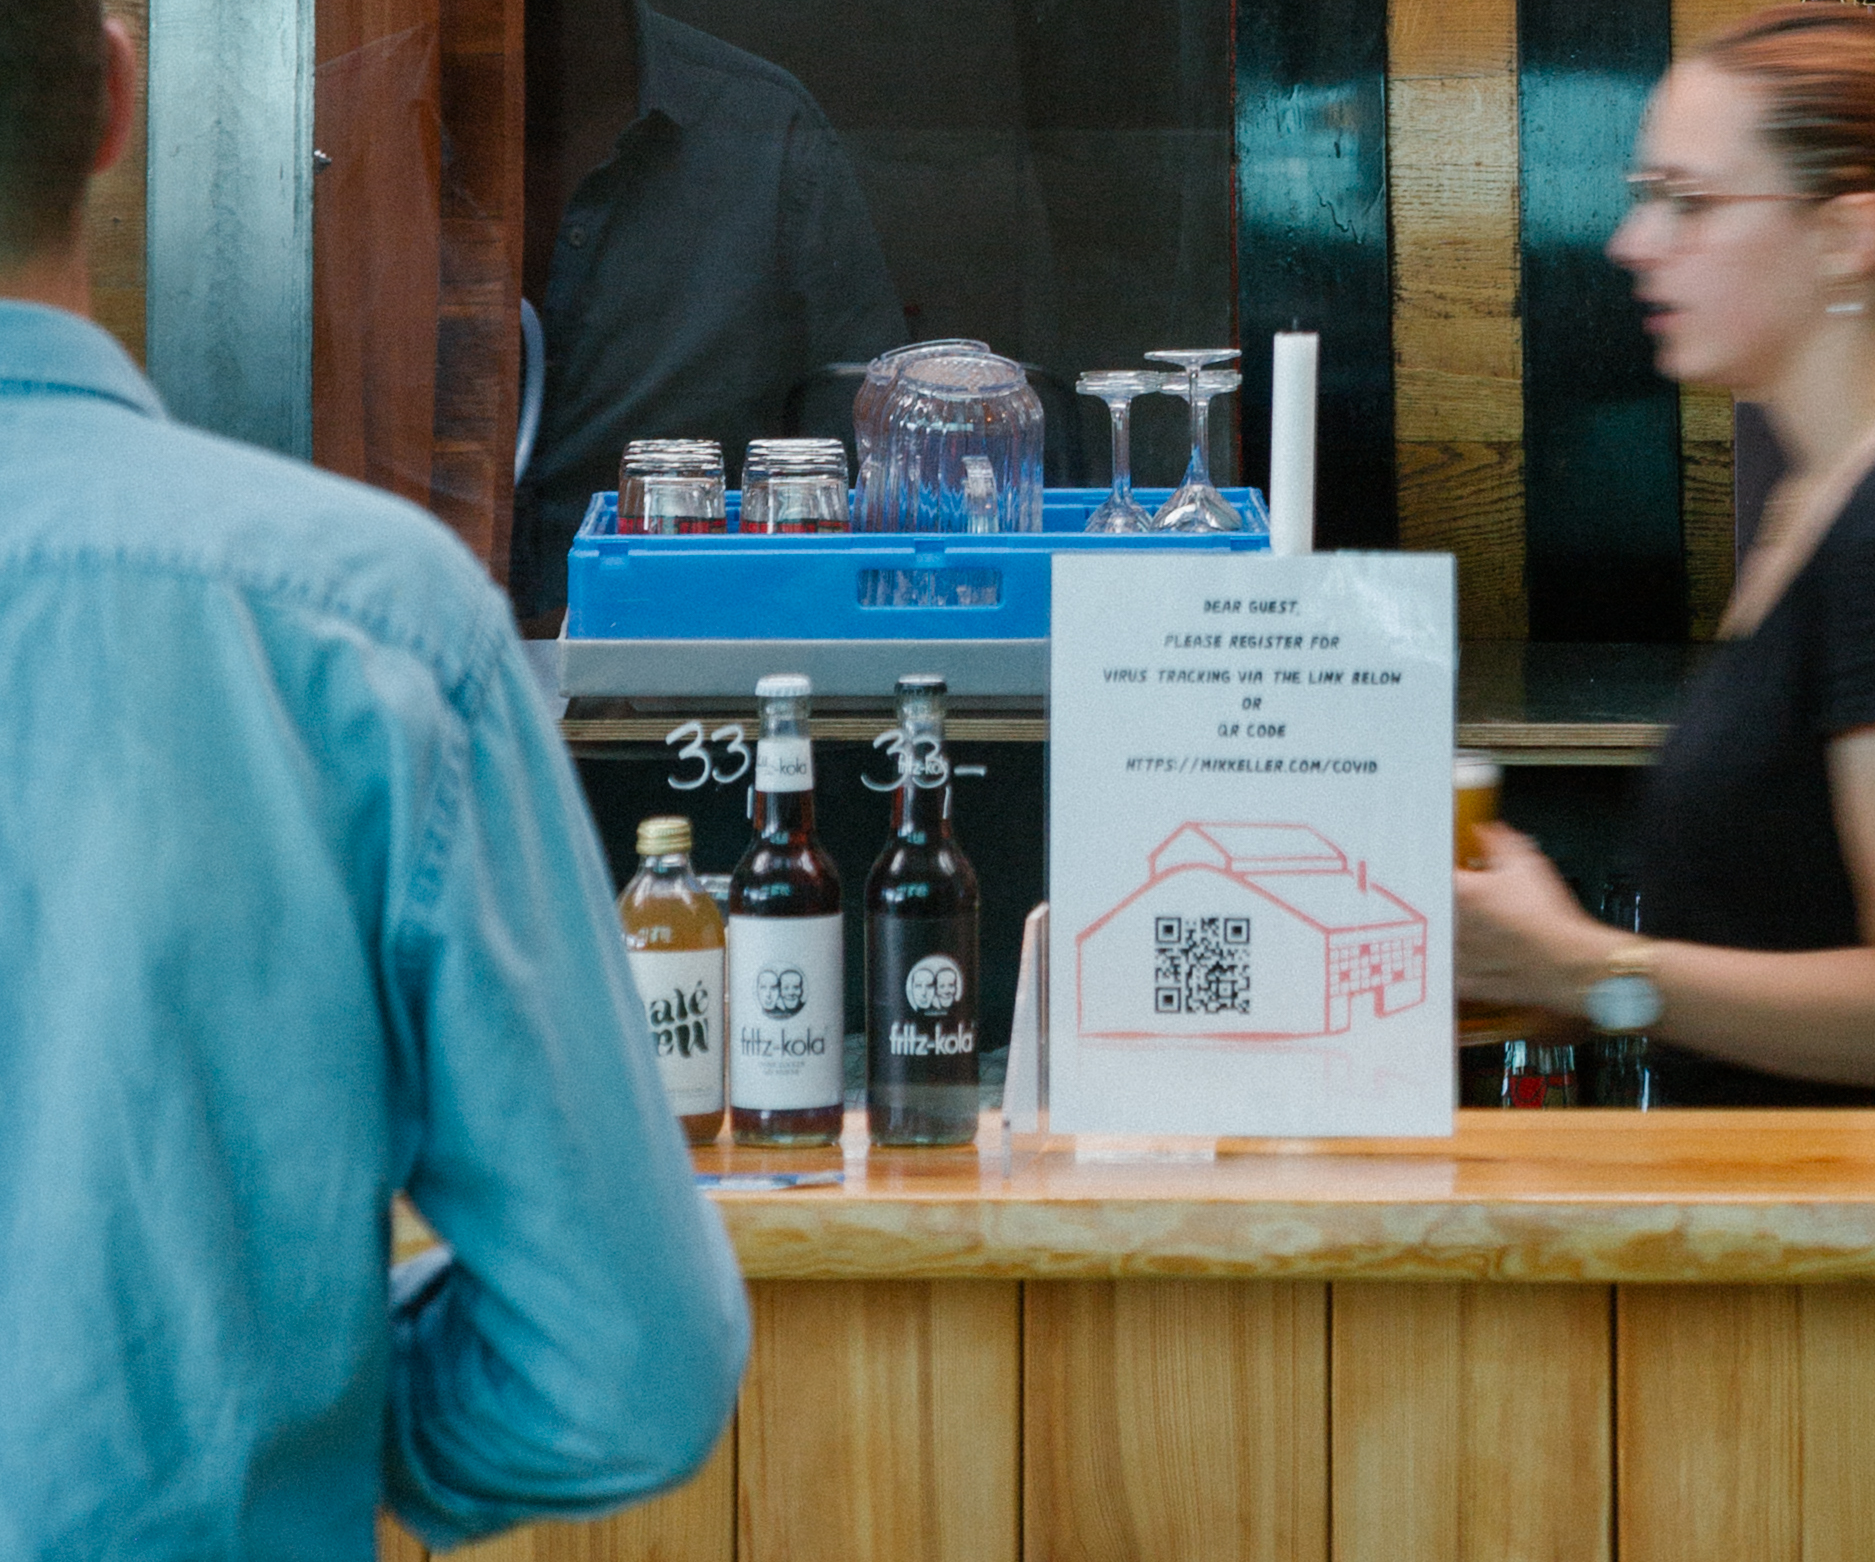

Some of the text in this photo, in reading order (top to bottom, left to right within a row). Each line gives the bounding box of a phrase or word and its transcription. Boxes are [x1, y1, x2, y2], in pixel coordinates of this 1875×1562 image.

[1203, 600, 1243, 613] DEAR
[1164, 635, 1341, 649] PLEASE REGISTER FOR
[1102, 670, 1403, 684] VIRUS TRACKING VIA THE LINK BELOW
[1242, 697, 1262, 711] OR
[1218, 724, 1287, 738] QR CODE
[1126, 758, 1378, 773] HTTPS://MIKKELLER.COM/COVID
[741, 1027, 825, 1057] fritz-kola
